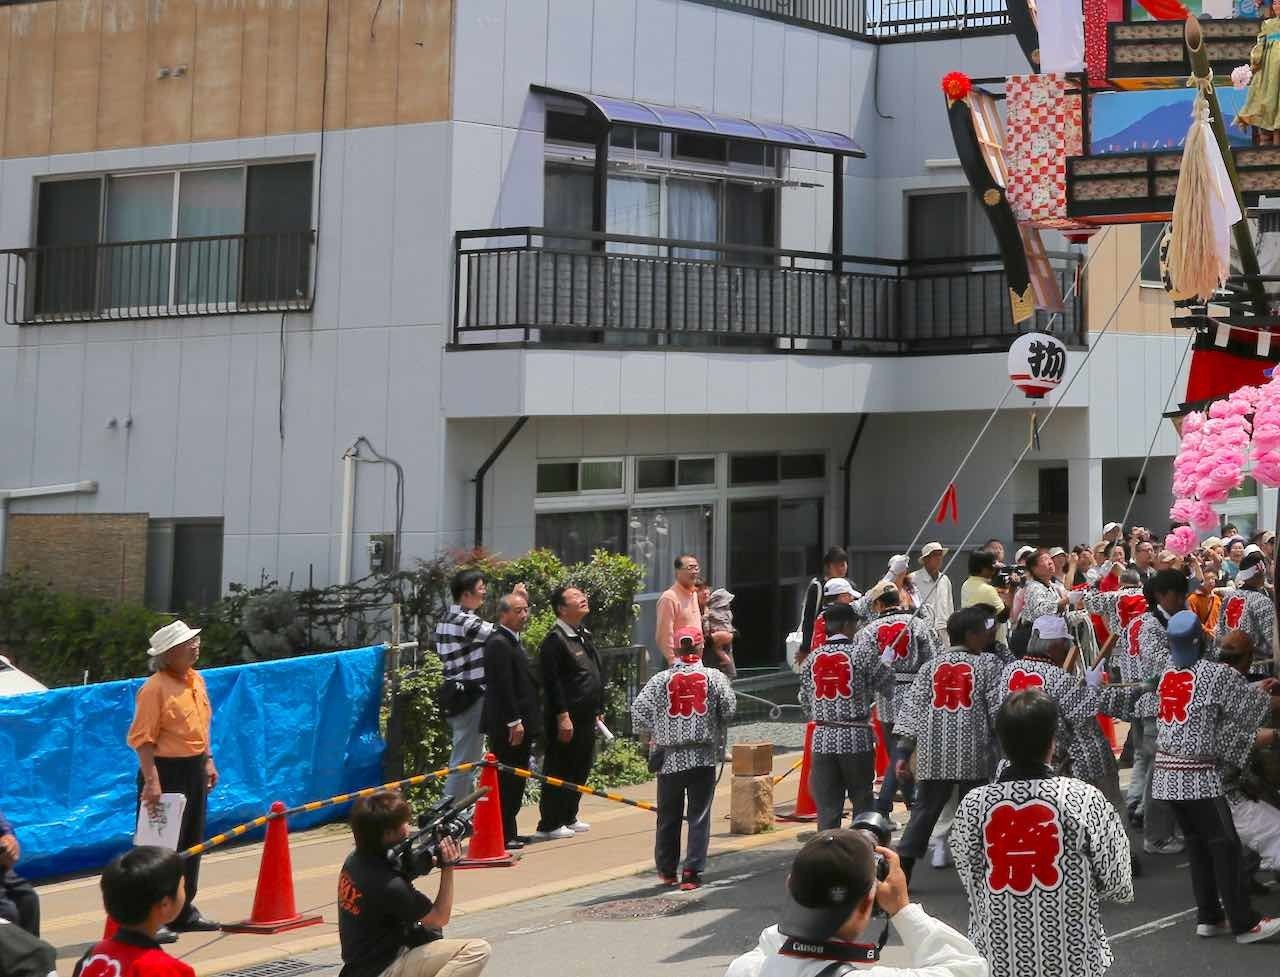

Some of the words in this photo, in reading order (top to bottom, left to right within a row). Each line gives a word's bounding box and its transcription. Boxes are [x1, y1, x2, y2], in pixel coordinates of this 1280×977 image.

[667, 672, 708, 718] 祭
[811, 653, 852, 700] 祭
[932, 664, 973, 711] 祭
[1158, 670, 1195, 723] 祭
[985, 804, 1060, 892] 祭
[792, 942, 824, 953] Canon
